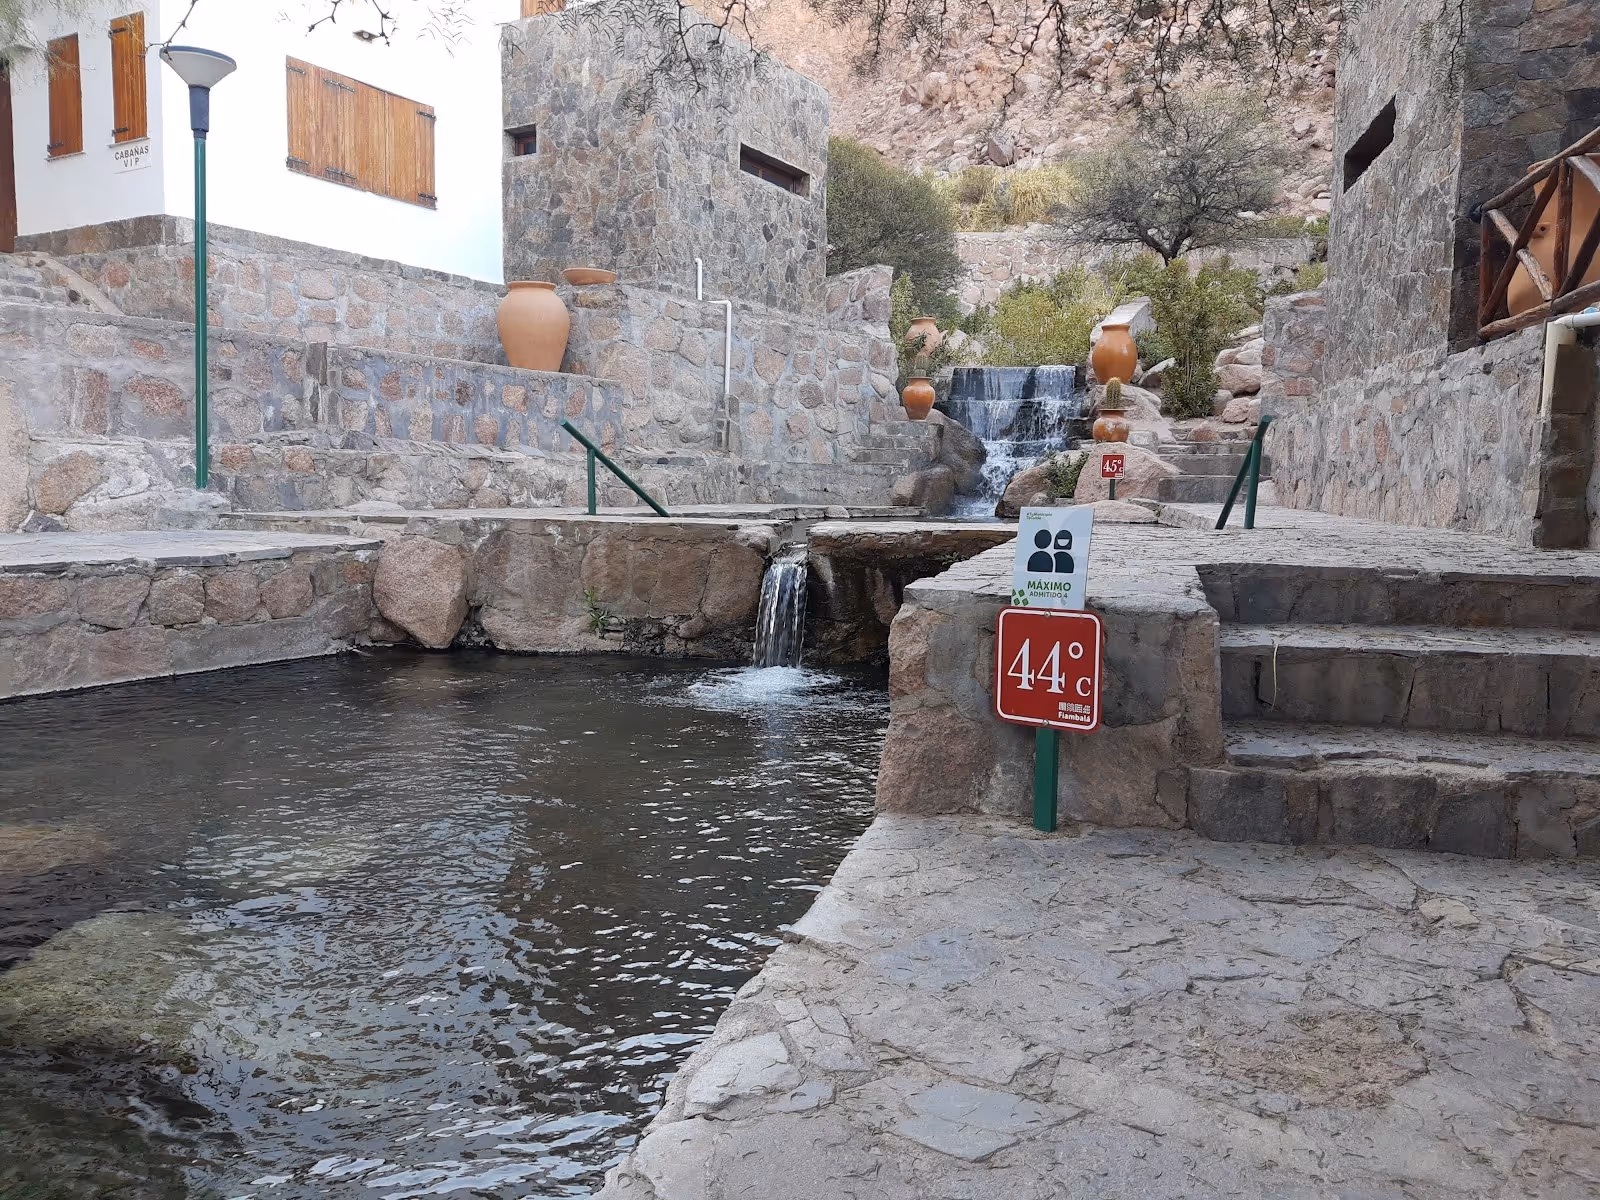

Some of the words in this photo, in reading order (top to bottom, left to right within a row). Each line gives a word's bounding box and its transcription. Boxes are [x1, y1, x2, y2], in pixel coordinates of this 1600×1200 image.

[124, 157, 140, 168] VIP
[1027, 578, 1072, 592] MÁXIMO
[1058, 711, 1090, 723] Fiambalá
